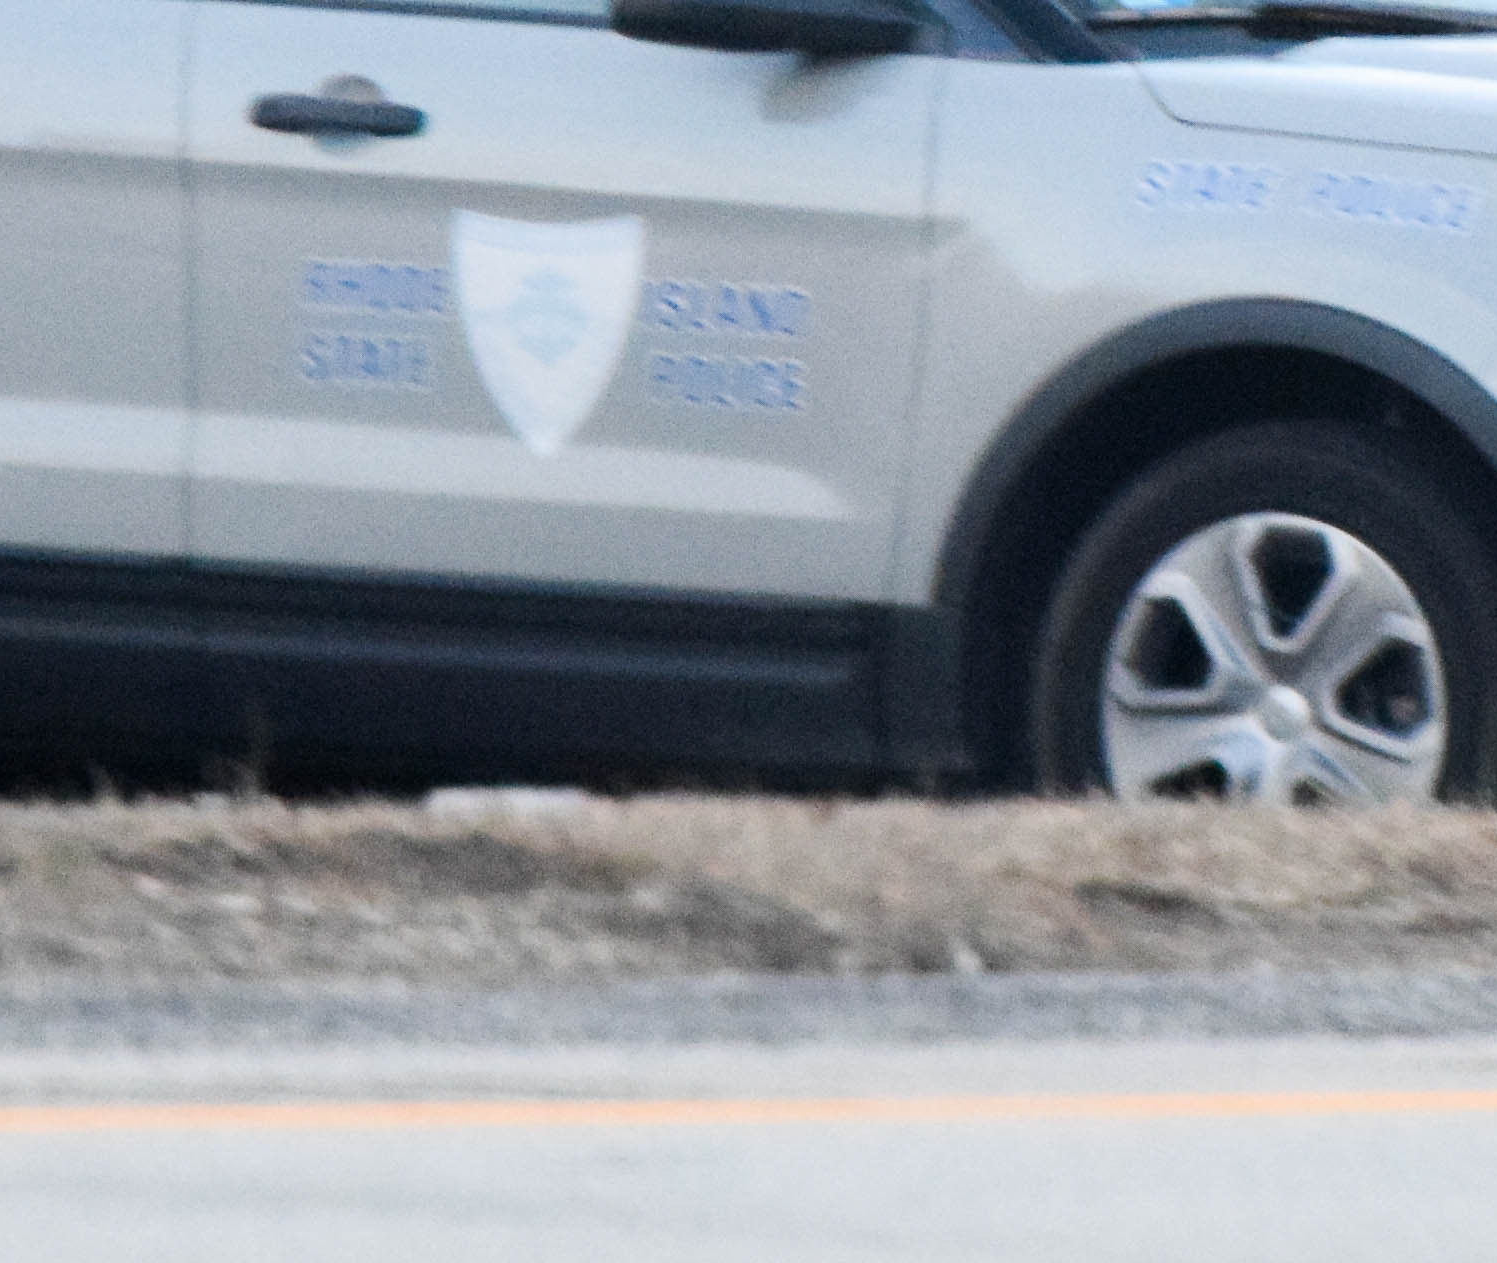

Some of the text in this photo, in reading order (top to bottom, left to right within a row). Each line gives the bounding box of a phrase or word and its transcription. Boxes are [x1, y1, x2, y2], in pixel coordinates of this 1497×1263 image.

[1134, 159, 1476, 233] STATE POLICE
[303, 259, 812, 336] RHODE ISLAND
[302, 333, 807, 410] STATE POLICE
